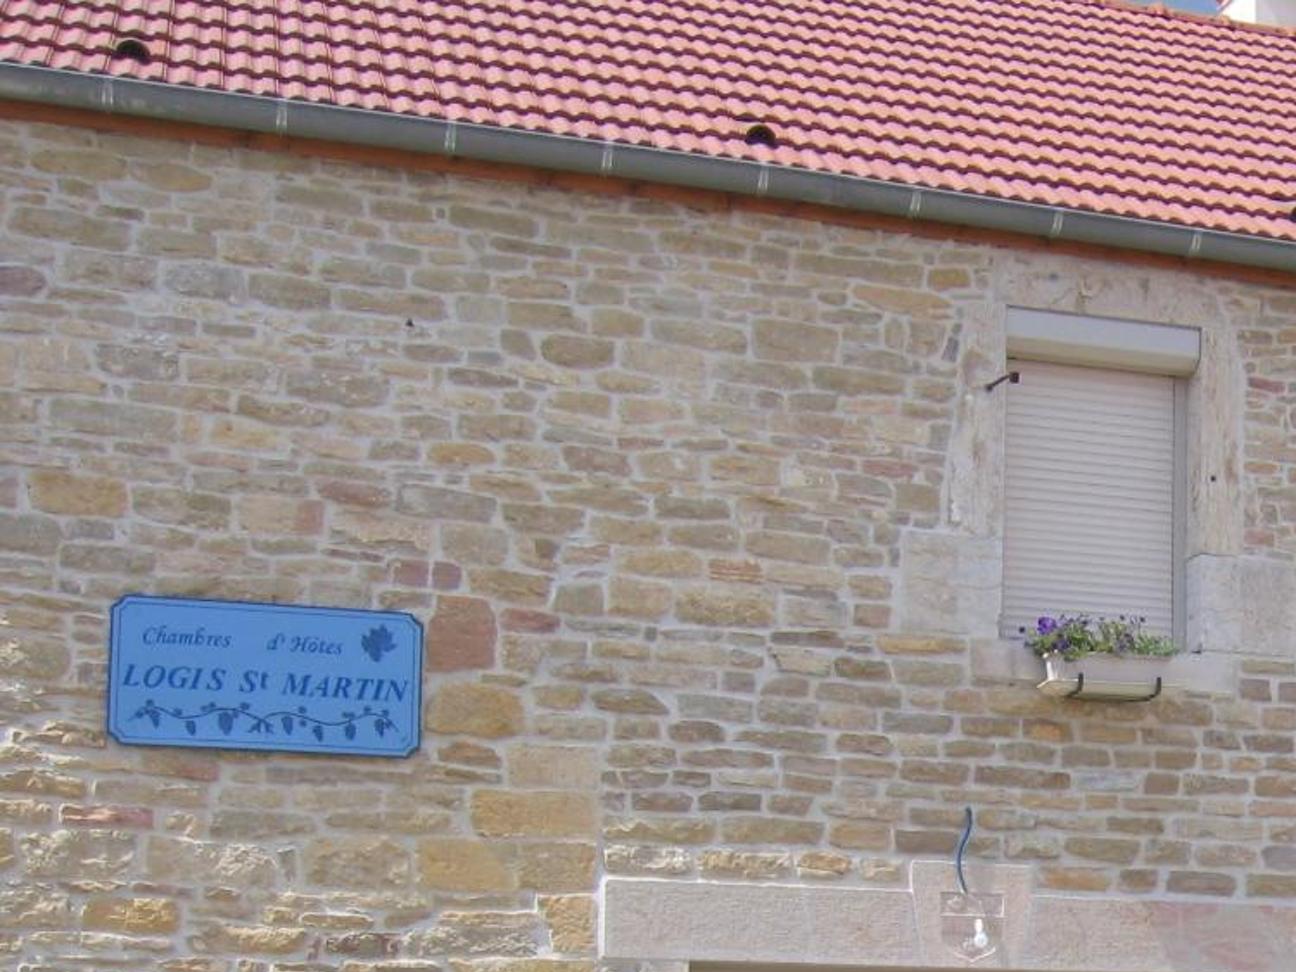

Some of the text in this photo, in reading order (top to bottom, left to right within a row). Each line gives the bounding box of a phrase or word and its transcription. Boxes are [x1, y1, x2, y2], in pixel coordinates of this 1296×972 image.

[142, 624, 232, 648] Chambres
[122, 663, 409, 702] LOGIS St MARTIN
